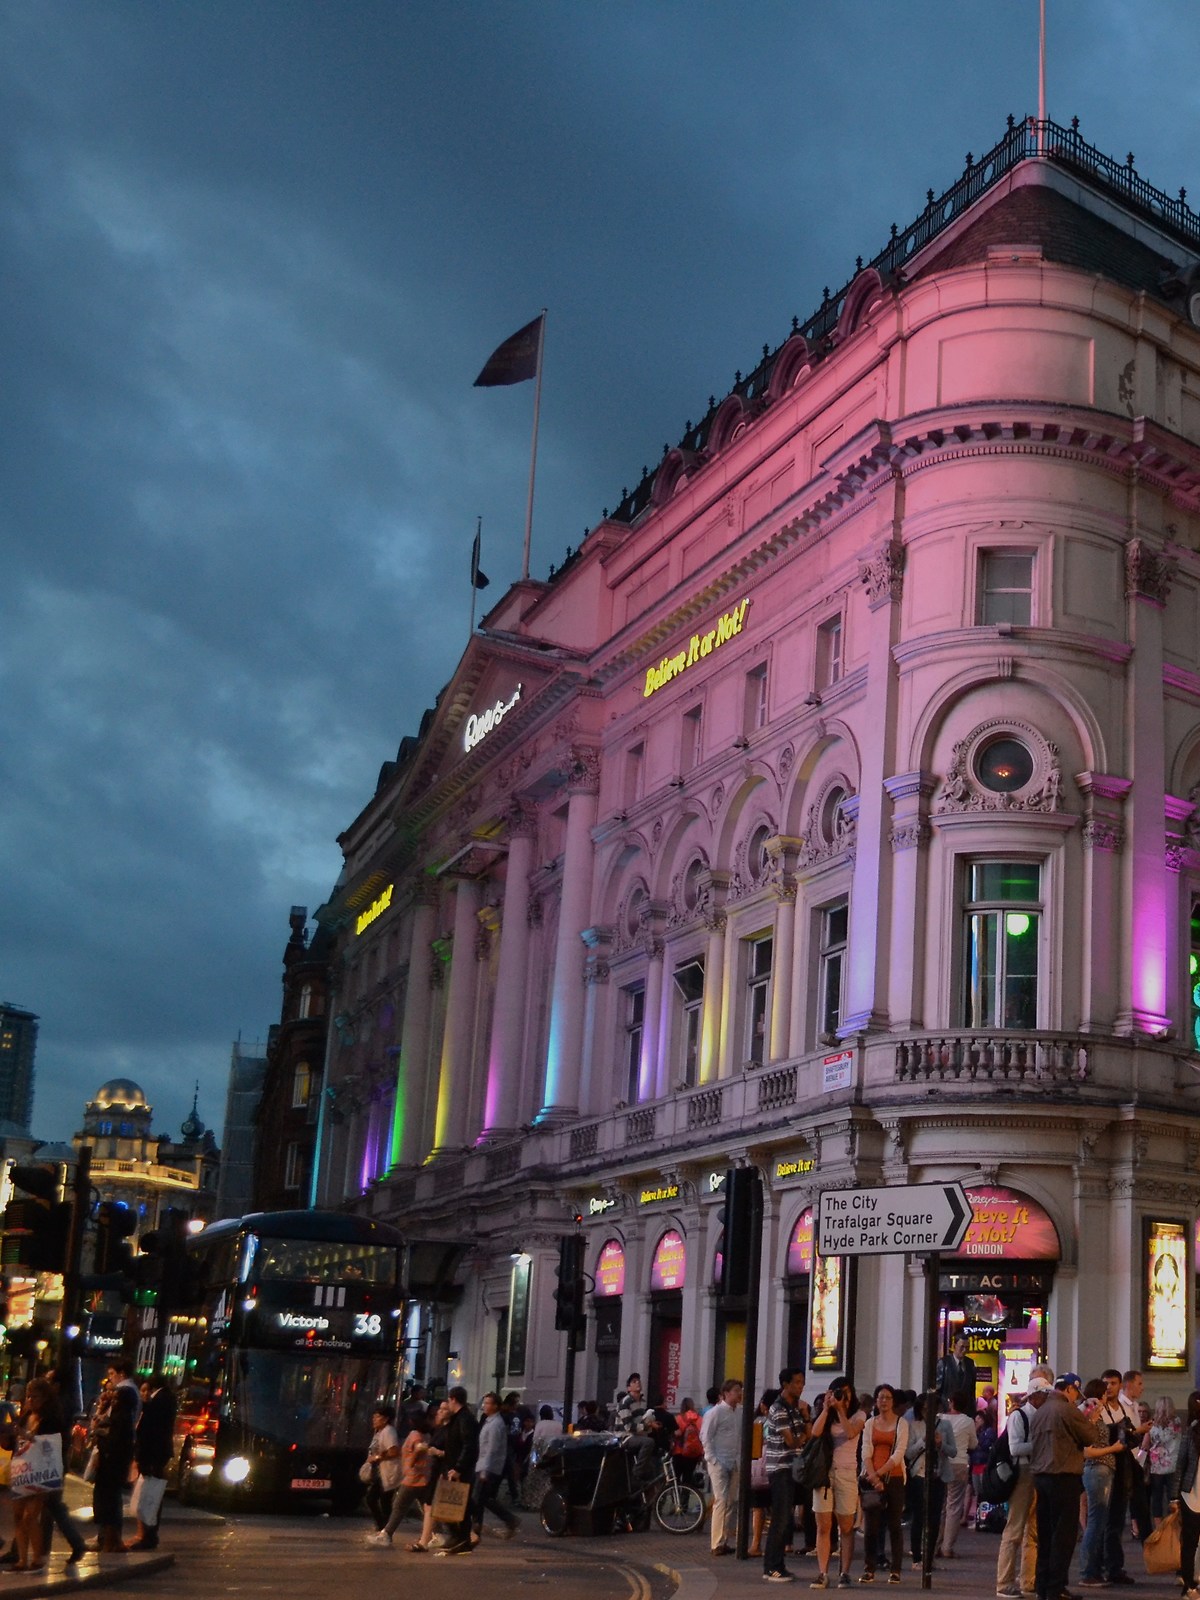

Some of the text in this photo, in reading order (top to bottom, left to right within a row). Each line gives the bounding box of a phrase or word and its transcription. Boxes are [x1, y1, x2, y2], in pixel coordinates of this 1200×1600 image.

[643, 599, 749, 698] Believe It or Not!
[825, 1196, 878, 1210] The City
[825, 1215, 881, 1230] Trafalgar
[887, 1212, 933, 1228] Square
[1012, 1207, 1029, 1224] It
[824, 1234, 855, 1250] Hyde
[860, 1233, 888, 1246] Park
[893, 1231, 938, 1245] Corner
[965, 1226, 1017, 1243] r Not!
[966, 1244, 1003, 1254] LONDON
[940, 1275, 1042, 1288] ATTRACTION
[280, 1313, 381, 1335] Victoria 38
[94, 1336, 123, 1346] Victori
[323, 1339, 351, 1349] nothing
[667, 1342, 679, 1382] Believe
